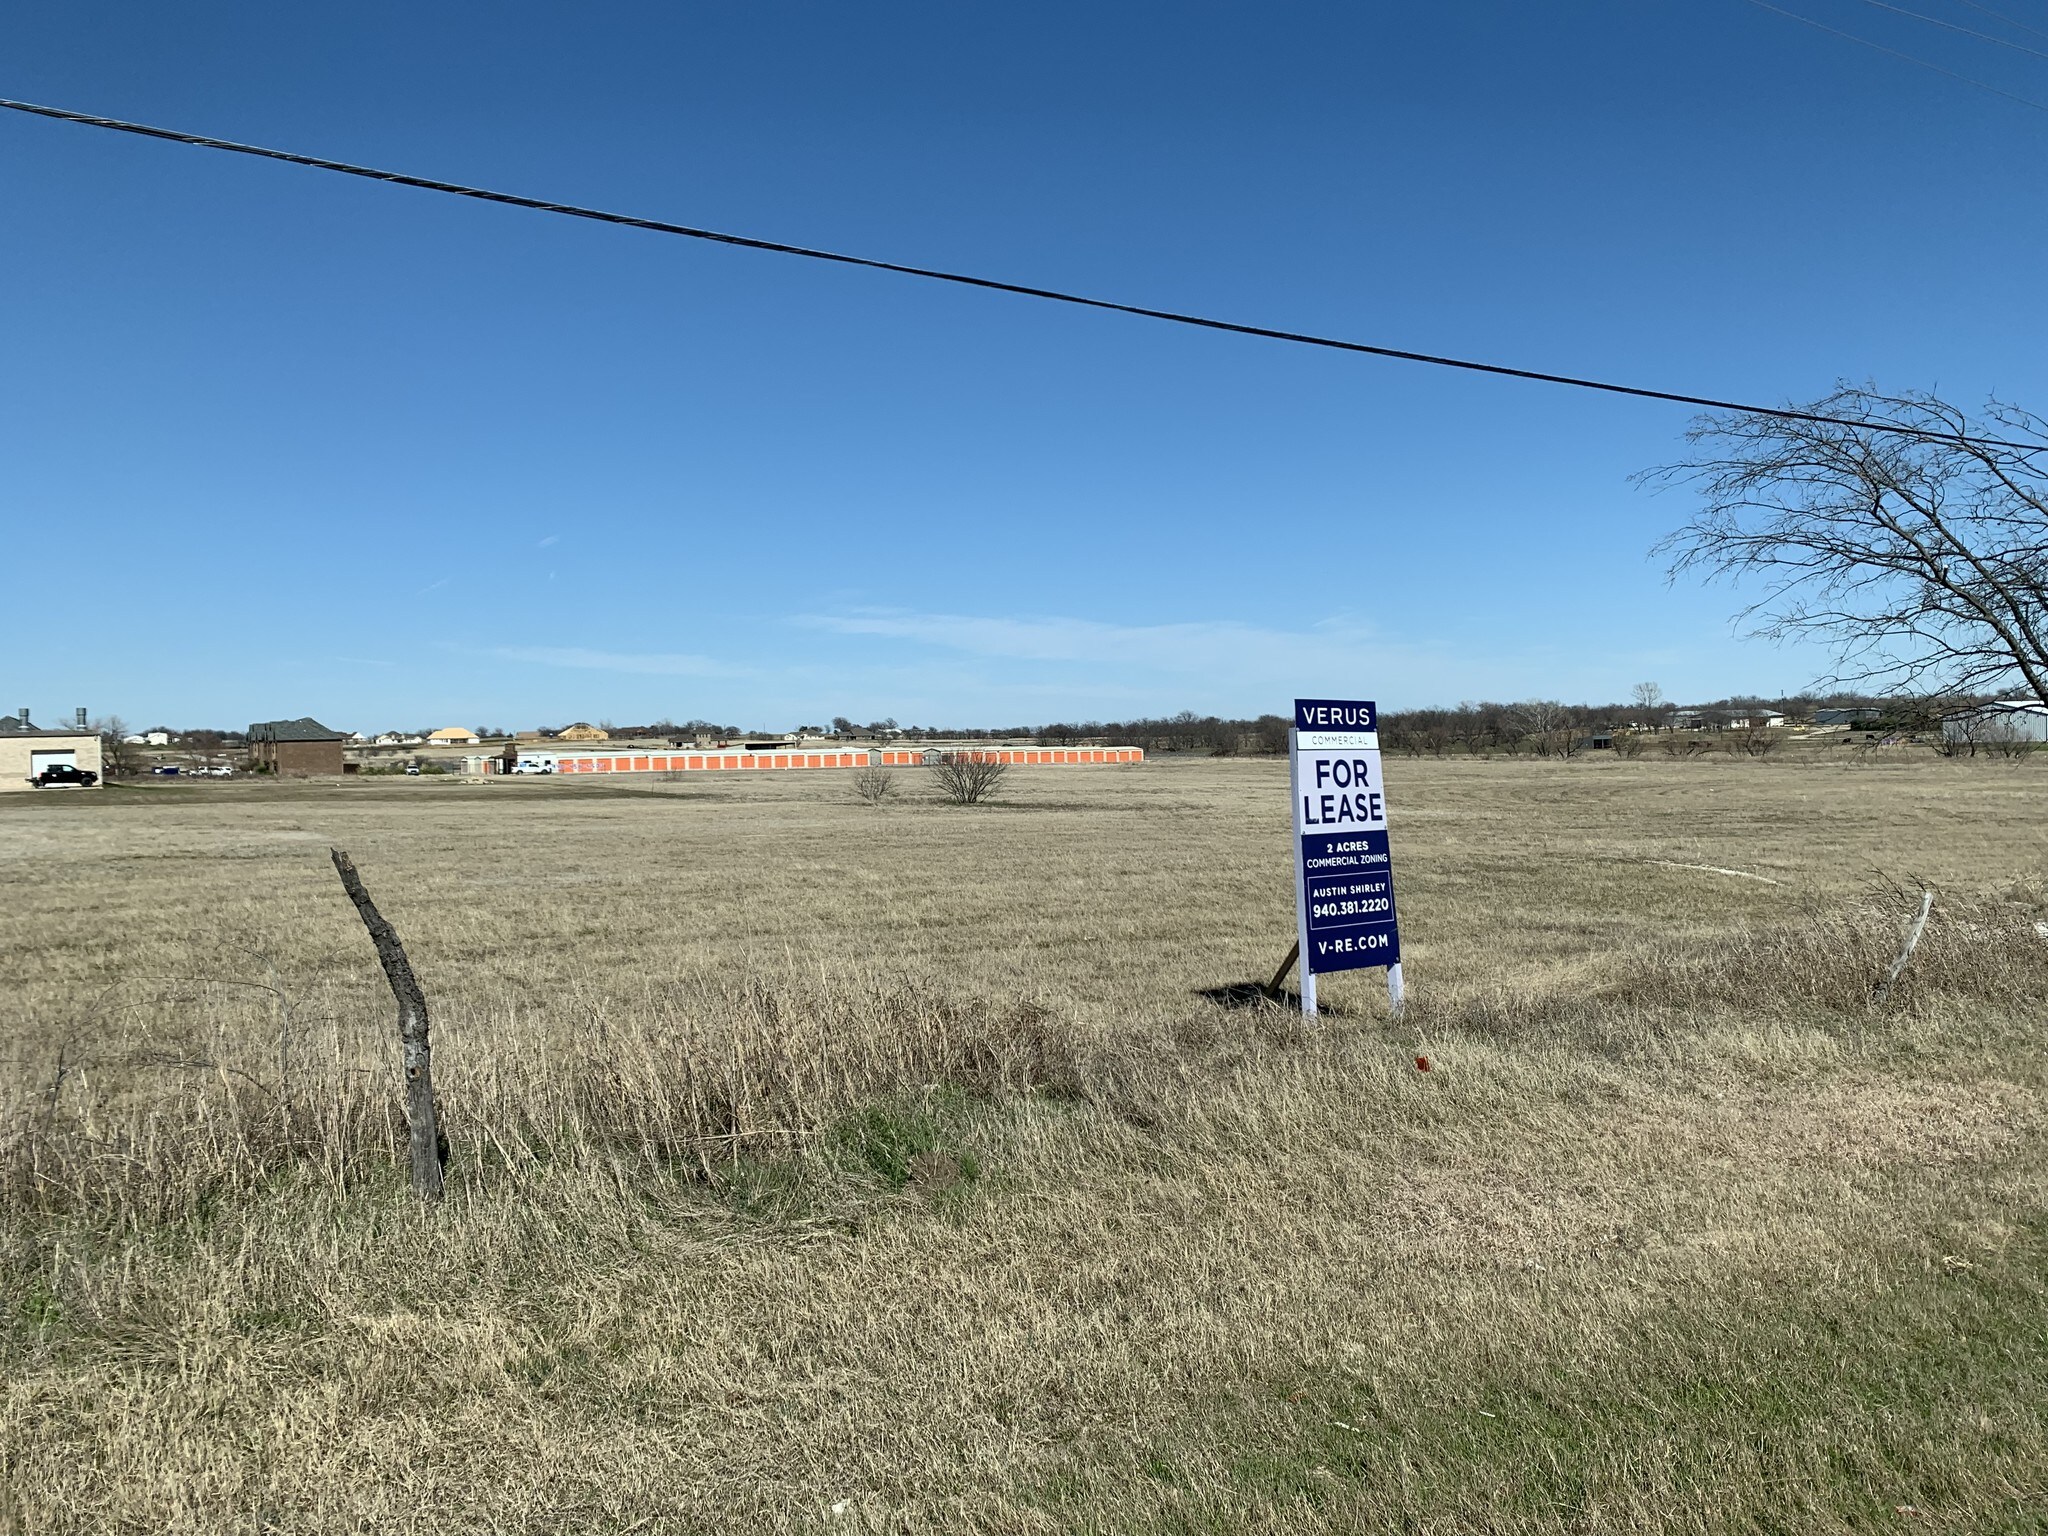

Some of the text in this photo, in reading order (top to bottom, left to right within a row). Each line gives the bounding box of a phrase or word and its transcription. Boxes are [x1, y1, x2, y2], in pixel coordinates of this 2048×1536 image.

[1303, 707, 1370, 725] VERUS
[1311, 736, 1368, 745] COMMERCIAL
[1315, 759, 1369, 788] FOR
[1304, 793, 1383, 824] LEASE
[1327, 841, 1369, 853] 2 ACRES
[1306, 853, 1388, 868] COMMERCIAL ZONING
[1313, 882, 1386, 898] AUSTIN SHIRLEY
[1313, 897, 1389, 918] 940.381.2220
[1318, 934, 1389, 955] V-RE.COM
